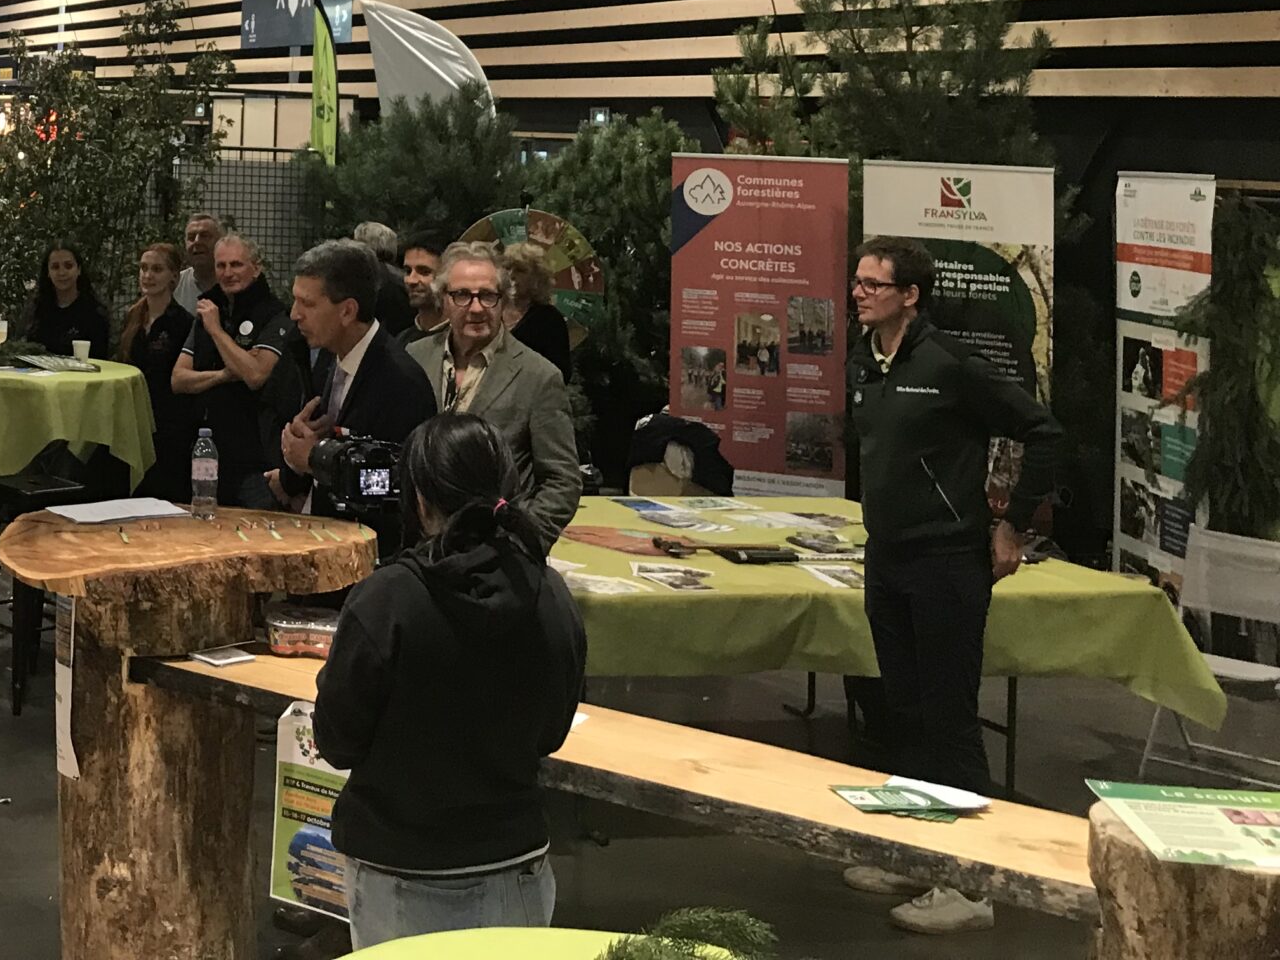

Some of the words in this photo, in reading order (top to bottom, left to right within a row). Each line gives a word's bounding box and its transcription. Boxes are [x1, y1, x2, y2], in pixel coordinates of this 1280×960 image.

[737, 175, 803, 187] Communes
[736, 187, 800, 199] forestières
[924, 208, 987, 222] FRANSYLVA
[714, 241, 742, 253] NOS
[745, 243, 802, 256] ACTIONS
[720, 258, 796, 273] CONCRÈTES
[934, 259, 974, 271] iétaires
[941, 272, 1011, 284] responsables
[942, 279, 955, 288] de
[957, 279, 967, 289] la
[969, 281, 1009, 292] gestion
